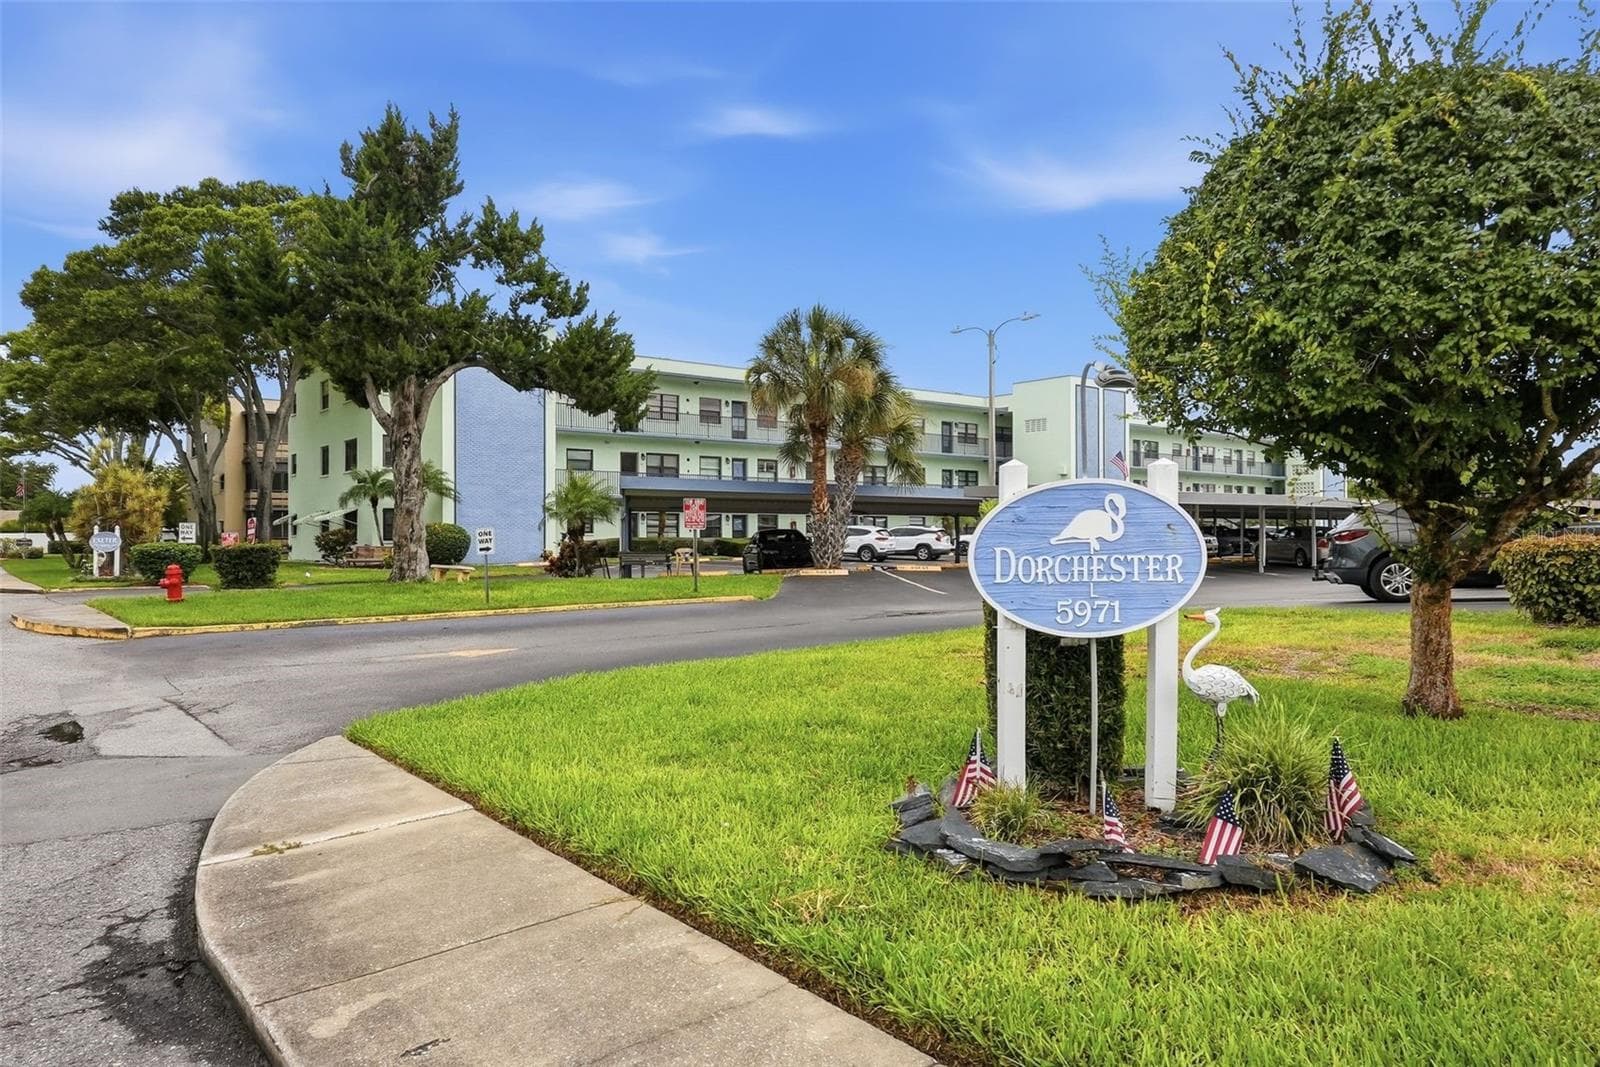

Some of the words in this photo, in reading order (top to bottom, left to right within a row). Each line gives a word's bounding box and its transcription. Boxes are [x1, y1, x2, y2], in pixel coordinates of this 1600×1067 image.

[477, 537, 493, 545] WAY
[478, 530, 492, 538] ONE
[992, 546, 1185, 586] DORCHESTER
[1055, 598, 1122, 628] 5971
